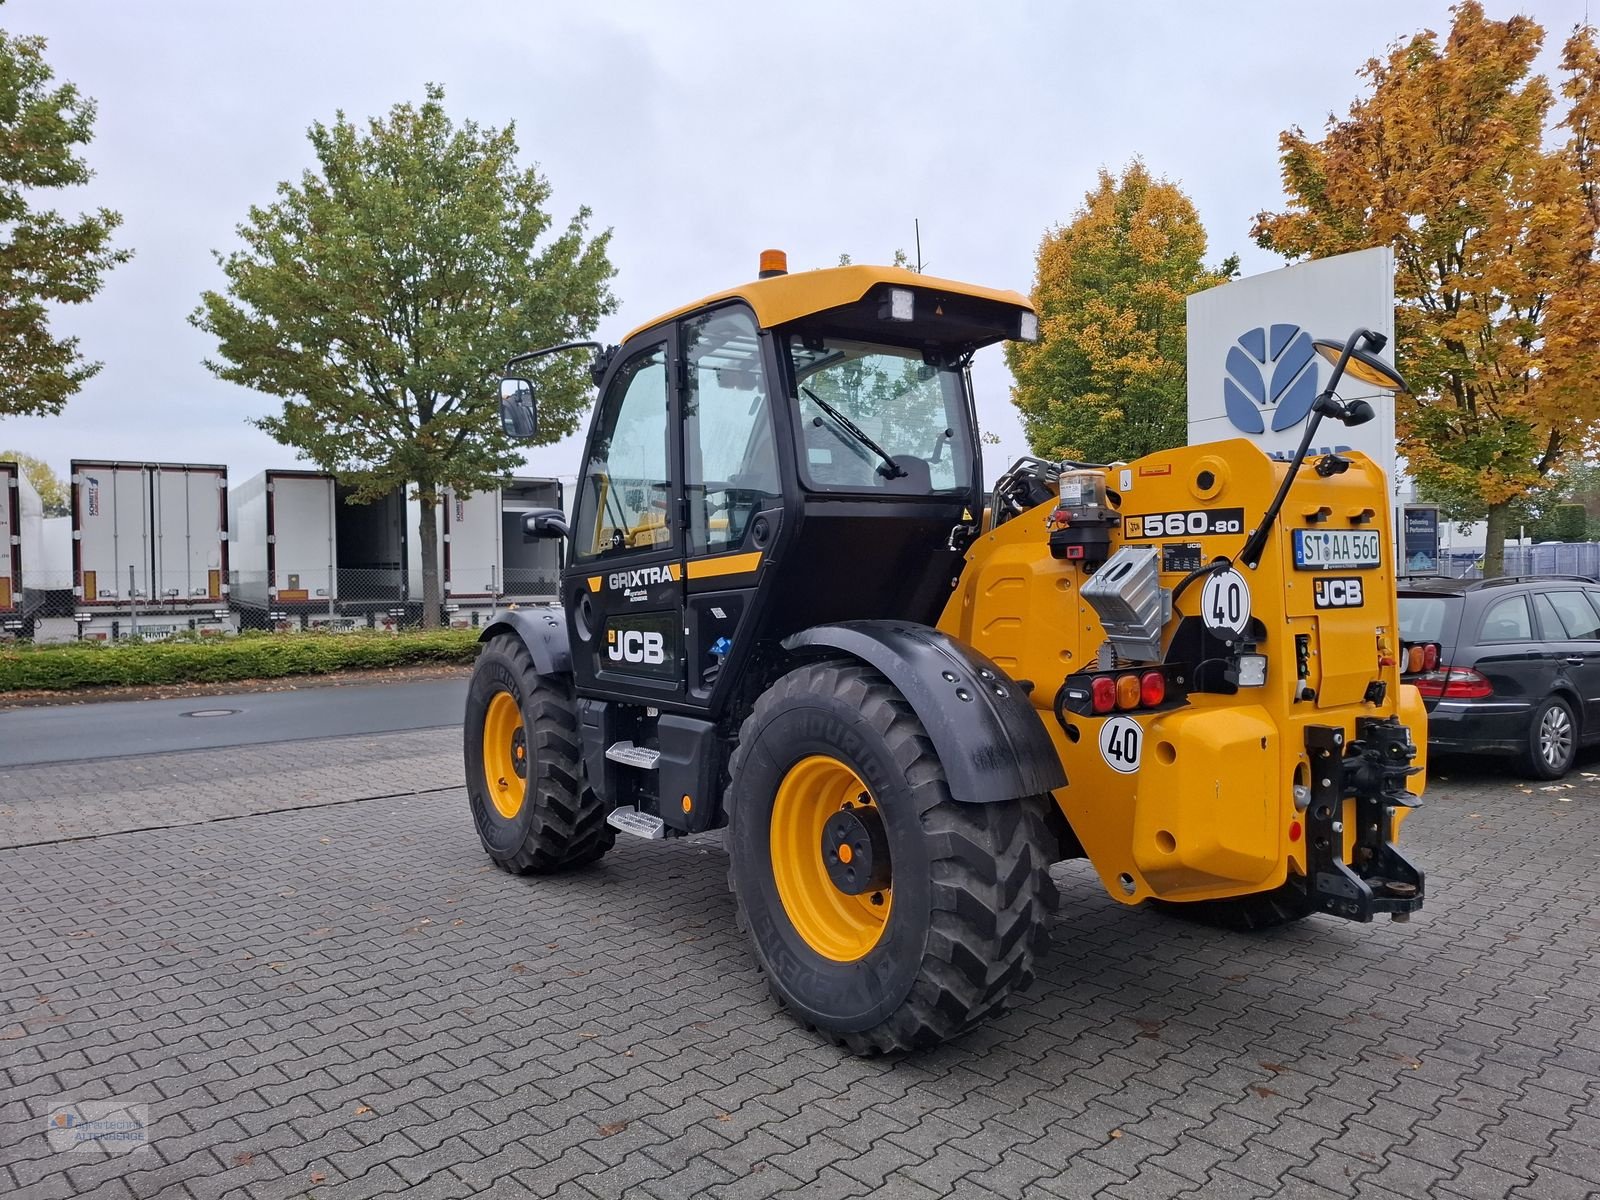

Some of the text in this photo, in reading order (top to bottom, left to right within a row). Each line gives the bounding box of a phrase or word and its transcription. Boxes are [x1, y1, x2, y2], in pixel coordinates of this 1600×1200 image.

[1304, 535, 1378, 560] ST AA 560
[608, 565, 673, 590] GRIXTRA
[1315, 579, 1362, 606] JCB
[1212, 583, 1240, 625] 40
[608, 630, 664, 665] JCB
[1107, 725, 1138, 764] 40
